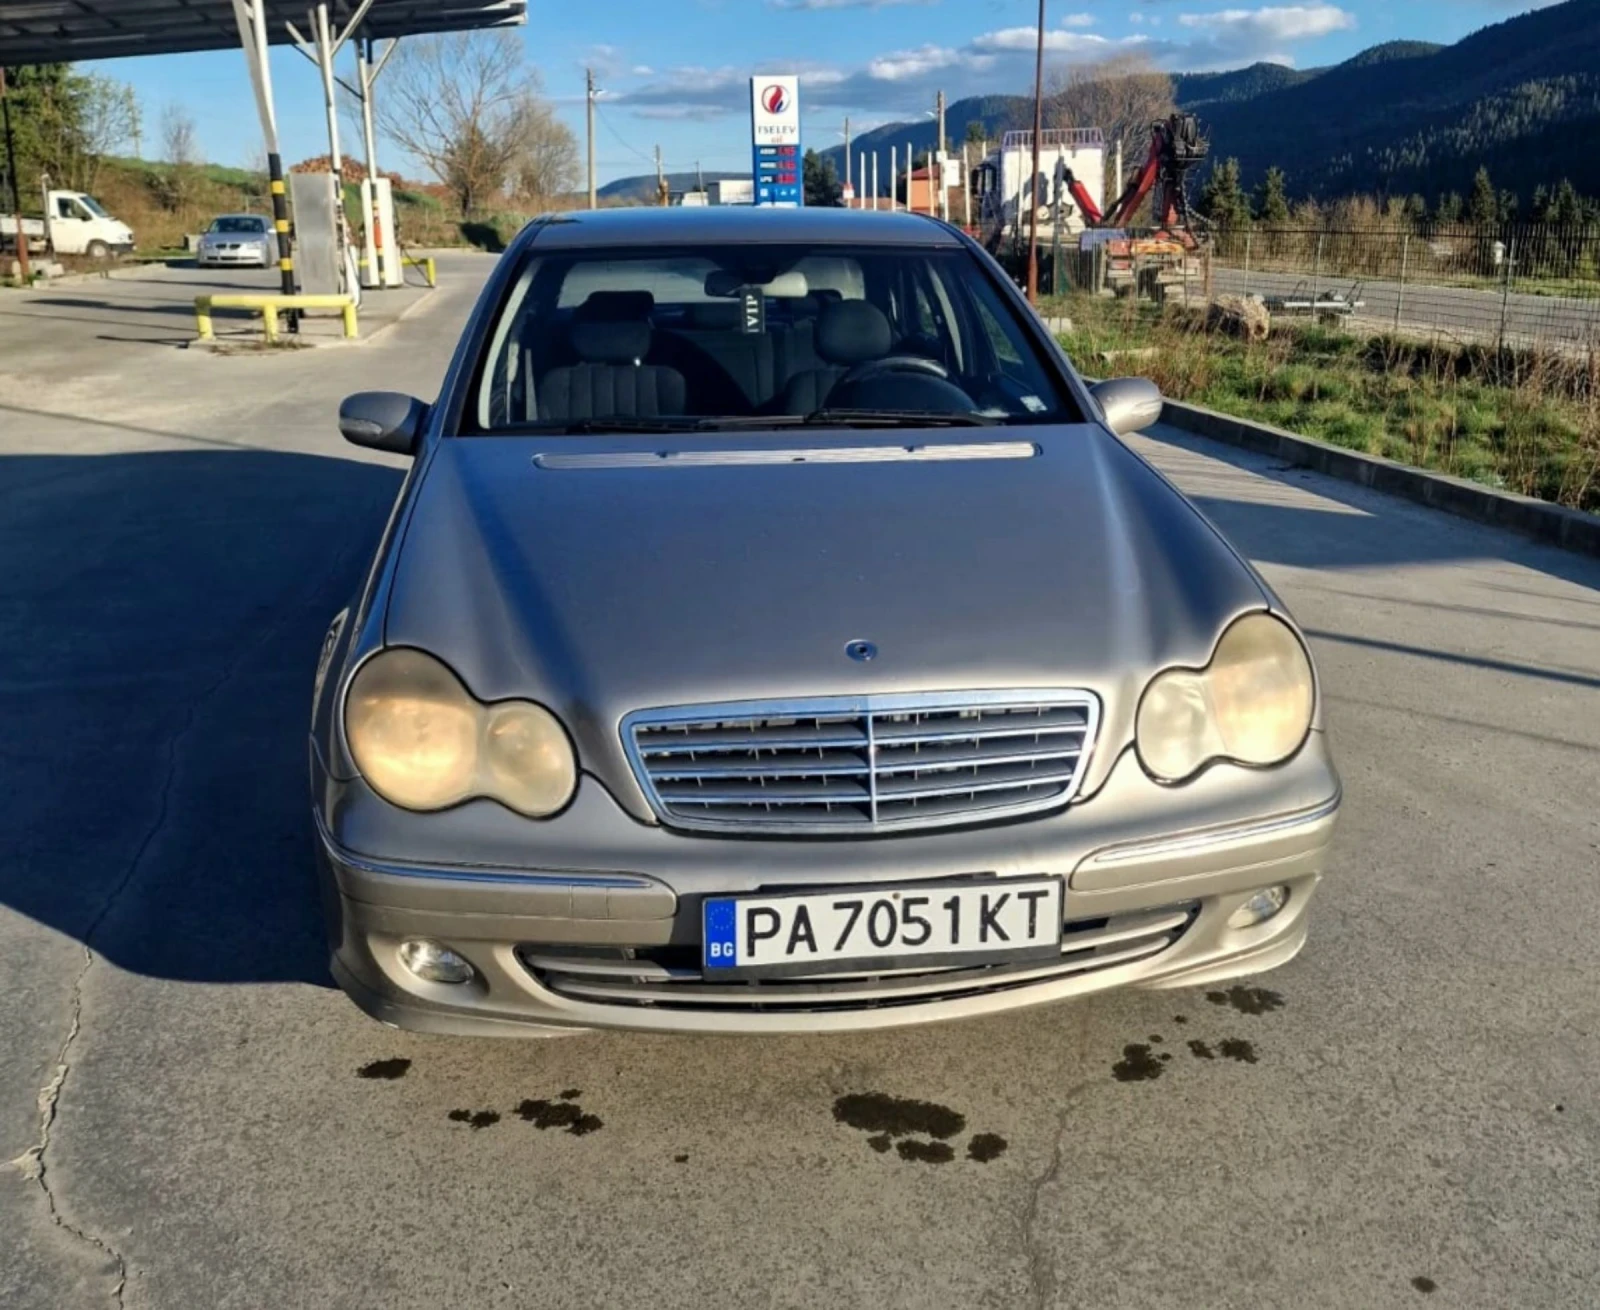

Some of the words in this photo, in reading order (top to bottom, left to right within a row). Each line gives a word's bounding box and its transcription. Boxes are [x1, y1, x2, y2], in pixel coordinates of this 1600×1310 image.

[746, 294, 759, 327] VIP
[746, 904, 818, 957] PA
[832, 896, 960, 949] 7051
[979, 889, 1049, 943] KT
[710, 942, 734, 957] BG
